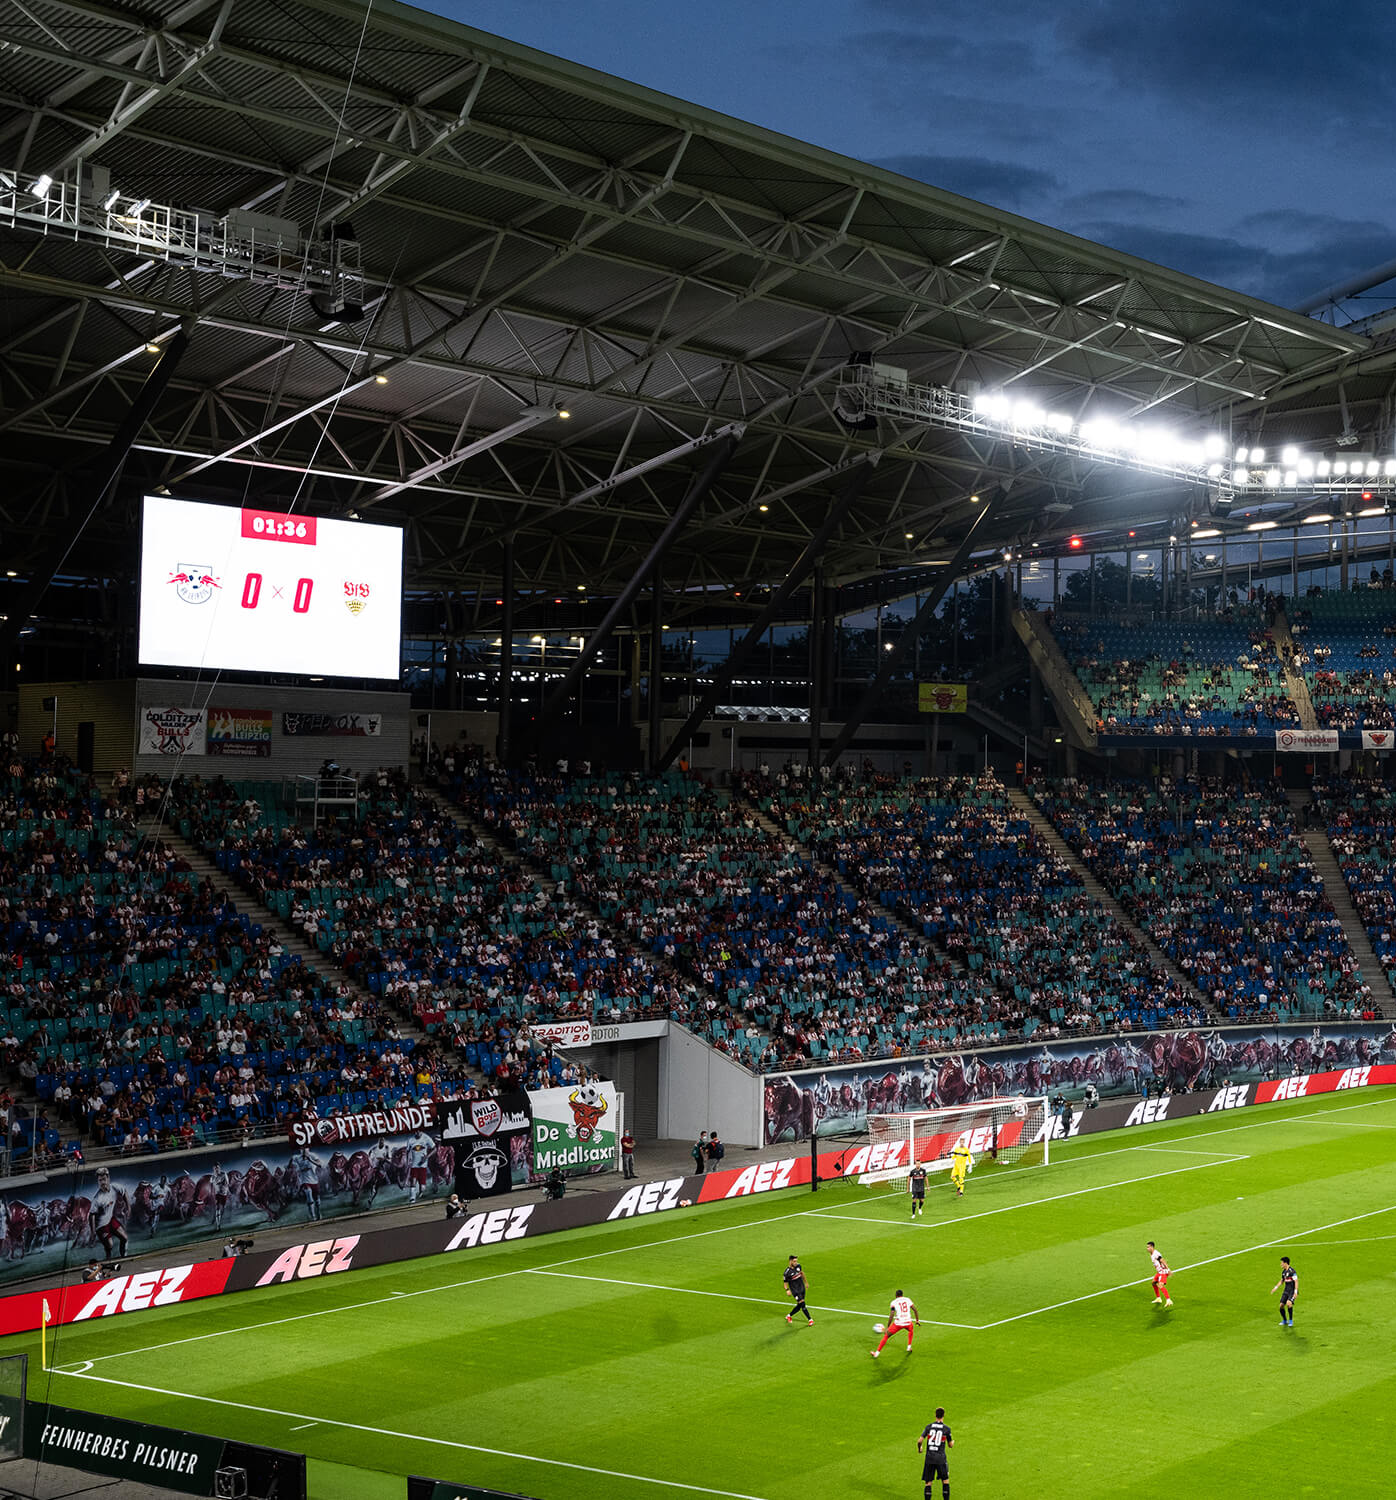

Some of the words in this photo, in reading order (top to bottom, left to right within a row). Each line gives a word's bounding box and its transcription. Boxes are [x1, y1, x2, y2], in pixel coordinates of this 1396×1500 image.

[253, 516, 307, 538] 01:36
[241, 572, 263, 609] 0
[293, 577, 314, 613] 0
[532, 1024, 589, 1037] TRADITION
[572, 1033, 590, 1043] 2.0
[1272, 1075, 1309, 1100] AEZ
[1335, 1066, 1372, 1090] AEZ
[473, 1103, 498, 1118] WILD
[1208, 1084, 1249, 1112] AEZ
[477, 1112, 497, 1128] Boyz
[1125, 1097, 1170, 1126] AEZ
[536, 1125, 559, 1143] De
[844, 1140, 907, 1175] AEZ
[725, 1158, 797, 1198] AEZ
[607, 1177, 685, 1221] AEZ
[444, 1205, 535, 1251] AEZ
[255, 1235, 360, 1286] AEZ
[73, 1264, 193, 1321] AEZ
[898, 1301, 908, 1313] 18
[41, 1424, 130, 1461] FEINHERBES
[133, 1443, 199, 1475] PILSNER
[928, 1429, 943, 1446] 20
